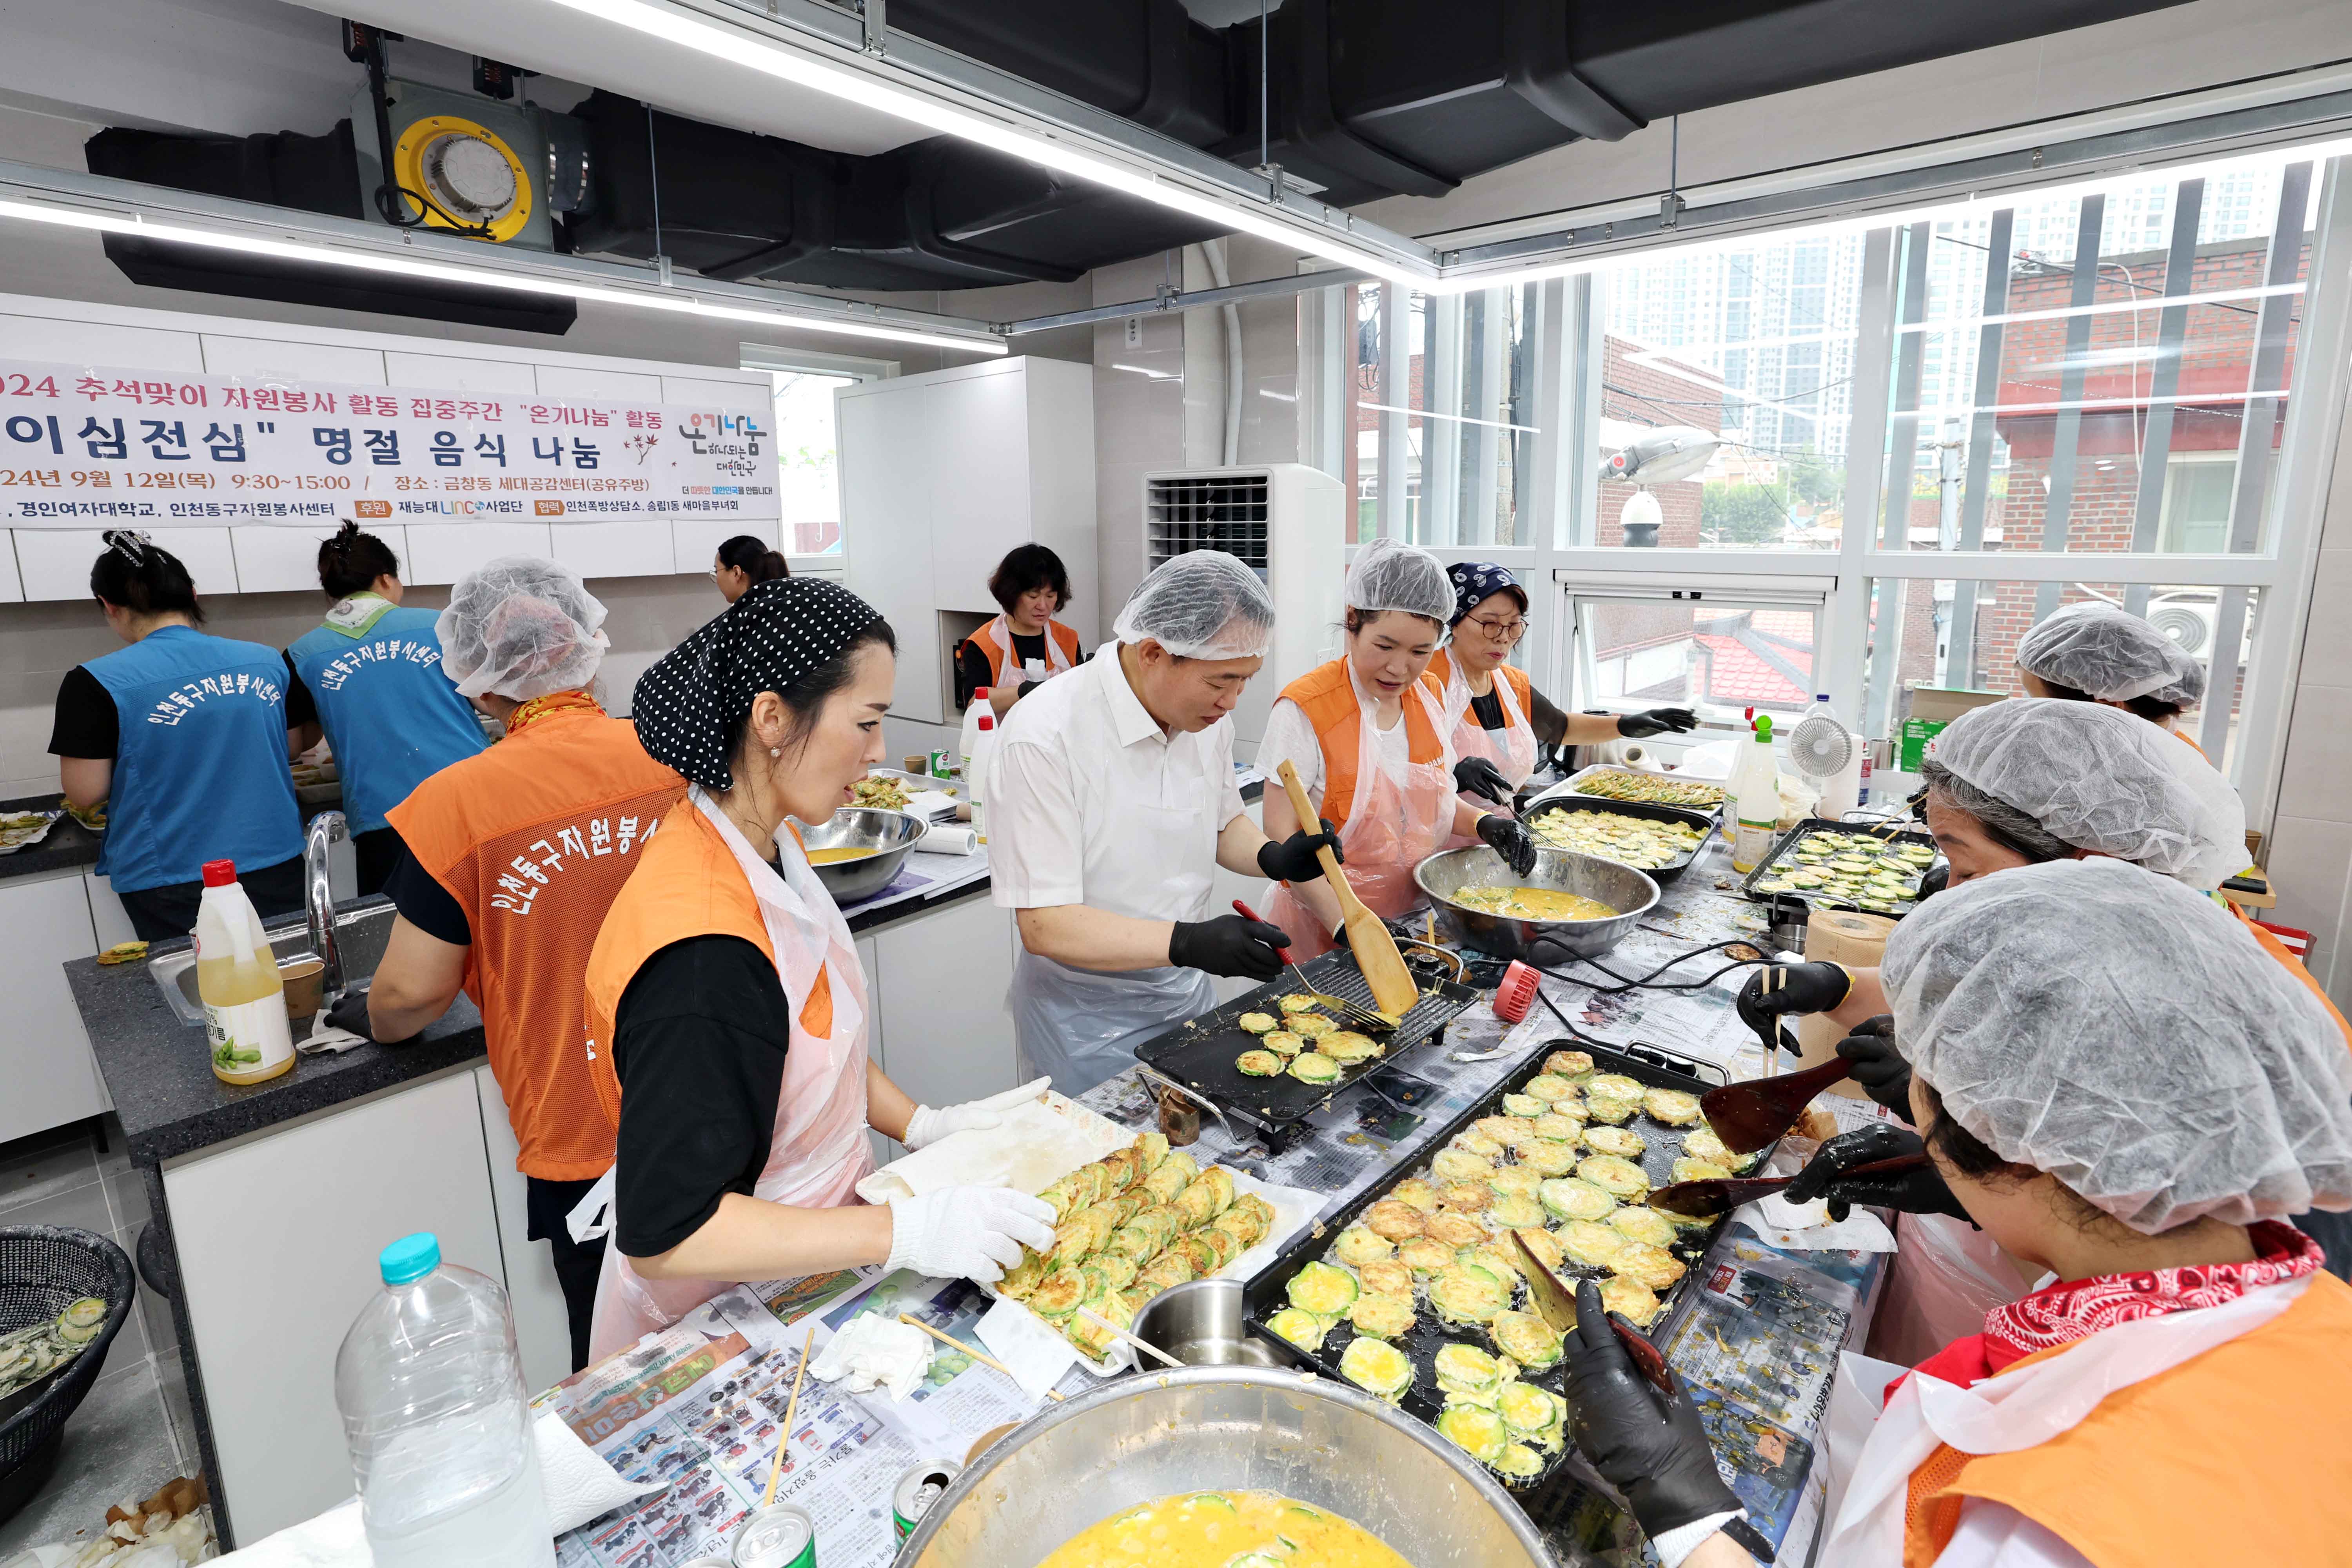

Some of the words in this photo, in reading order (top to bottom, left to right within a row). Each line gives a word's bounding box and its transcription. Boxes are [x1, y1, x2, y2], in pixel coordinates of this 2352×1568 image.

[76, 377, 207, 407] 추석맞이
[221, 387, 337, 414] 자원봉사
[348, 394, 398, 417] 활동
[410, 399, 503, 421] 집중주간
[520, 405, 617, 426] "온기나눔"
[626, 410, 662, 429] 활동
[679, 413, 767, 456] 온기나눔
[312, 428, 401, 465] 명절
[429, 431, 506, 467] 음식
[532, 437, 601, 469] 나눔
[708, 443, 746, 460] 하나되는
[716, 459, 756, 476] 대한민국
[71, 470, 112, 487] 9월
[124, 472, 215, 489] 12일(목)
[231, 474, 350, 490] 9:30~15:00
[395, 476, 429, 490] 장소
[444, 477, 492, 491] 금창동
[499, 477, 649, 492] 세대공감센터(공유주방)
[682, 486, 689, 495] 더
[690, 486, 710, 495] 따뜻한
[712, 486, 744, 495] 대한민국을
[17, 502, 161, 517] 경인여자대학교,
[170, 502, 334, 517] 인천동구자원봉사센터
[360, 502, 386, 515] 후원
[486, 501, 523, 513] 사업단
[538, 501, 560, 514] 협력
[566, 501, 644, 512] 인천쪽방상담소,
[647, 501, 679, 511] 송림1동
[683, 500, 738, 511] 새마을부녀회
[321, 640, 441, 691] 인천동구자원봉사센터
[147, 673, 281, 726] 인천동구자원봉사센터
[818, 1443, 853, 1470] 물가는
